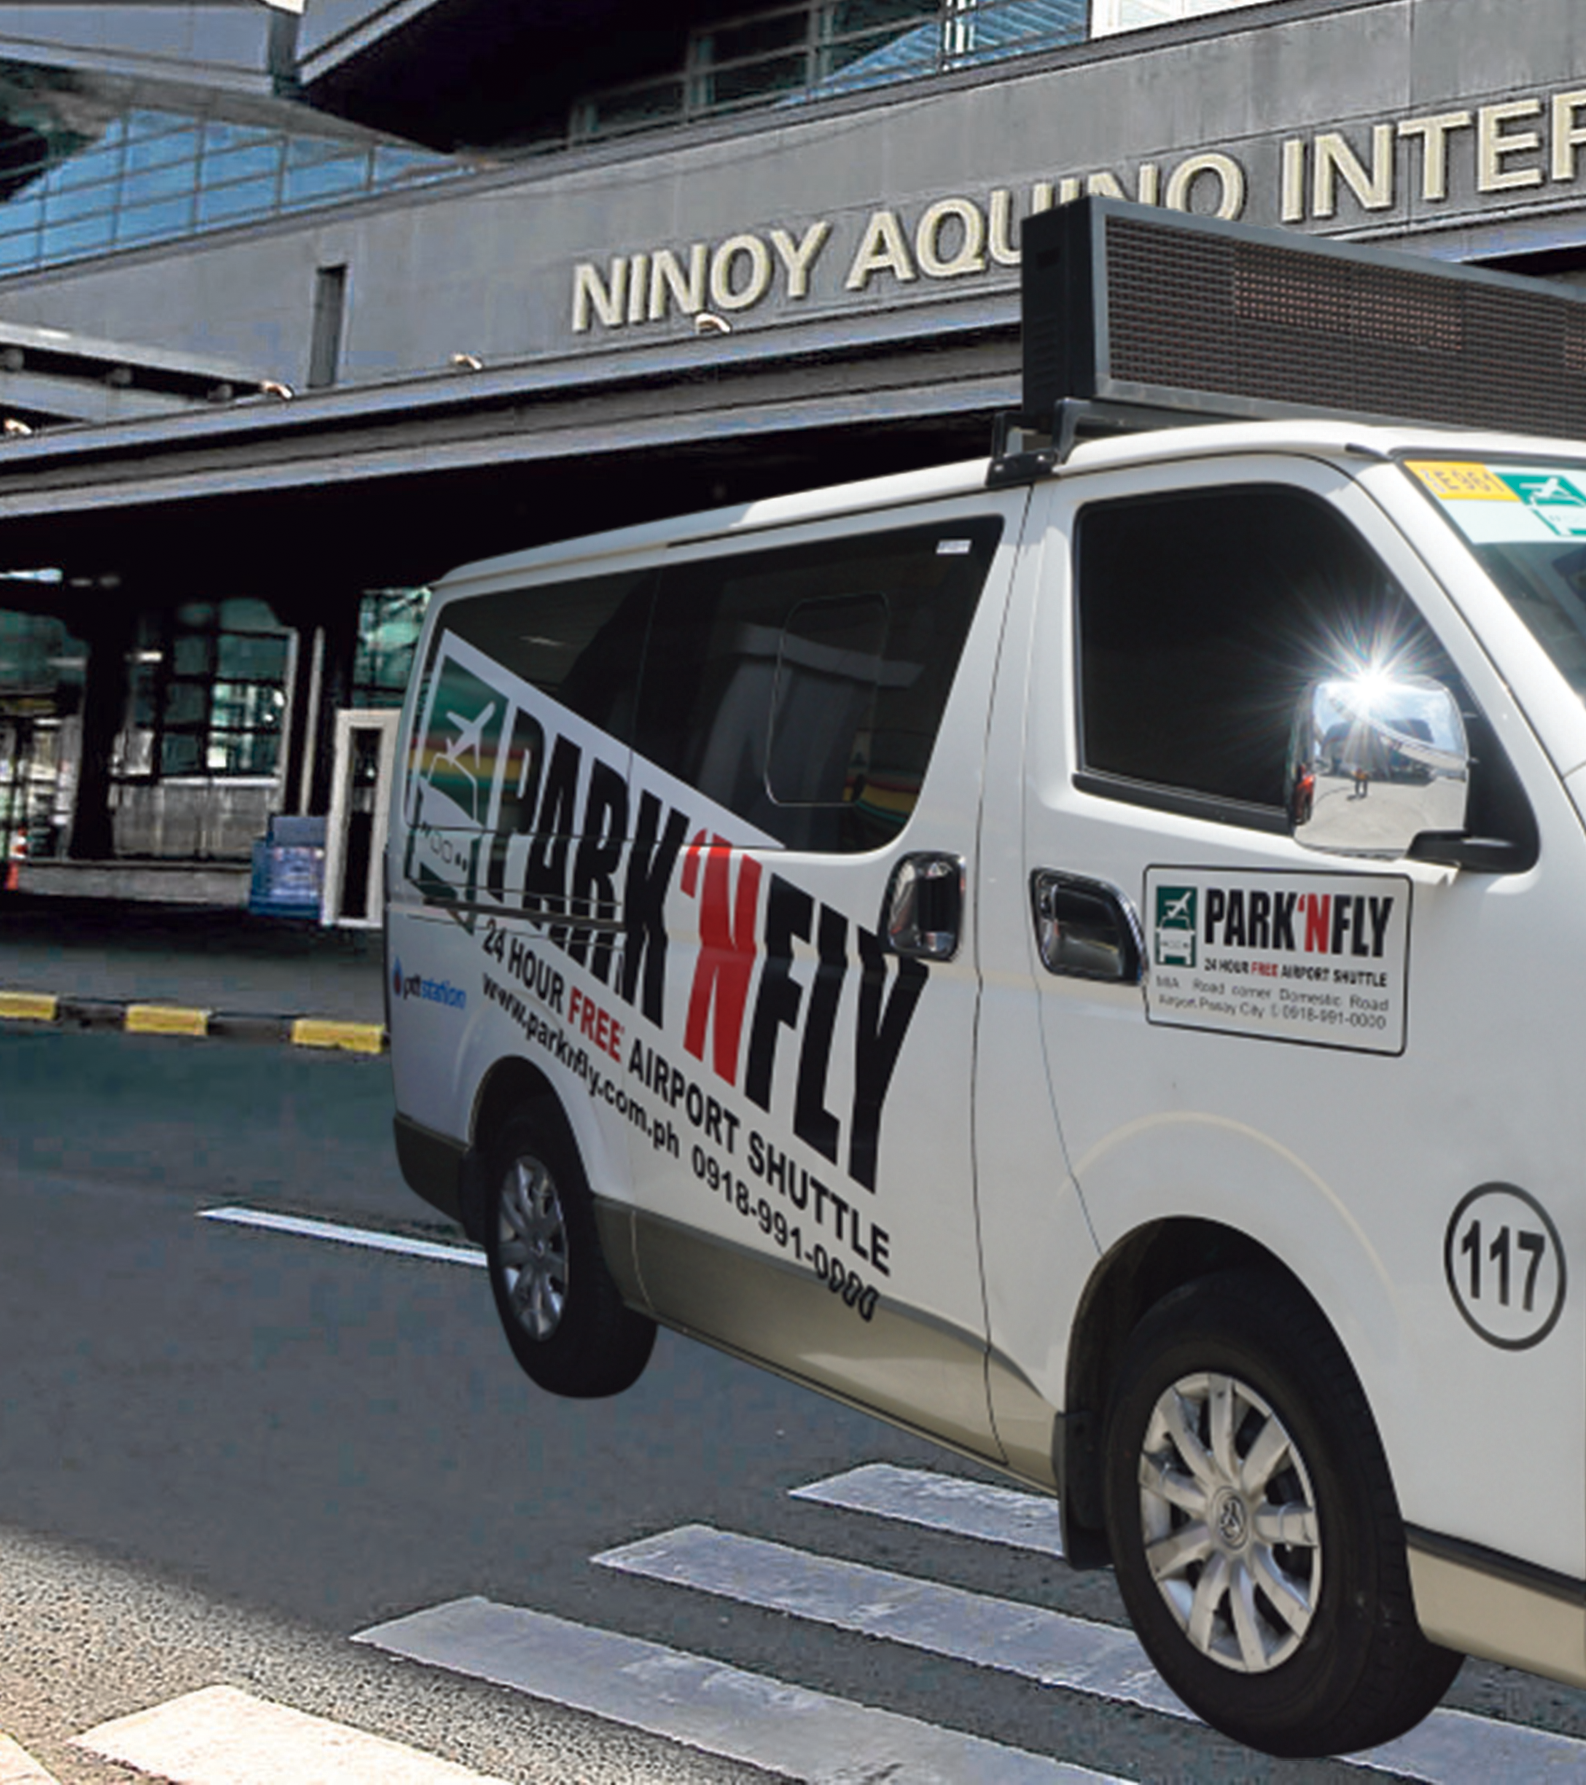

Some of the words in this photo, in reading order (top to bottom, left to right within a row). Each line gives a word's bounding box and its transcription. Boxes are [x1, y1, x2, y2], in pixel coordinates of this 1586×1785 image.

[572, 221, 832, 332] NINOY
[1193, 978, 1225, 995] Road
[1231, 985, 1271, 999] corner
[1279, 988, 1341, 1007] Domestic
[1349, 994, 1389, 1011] Road
[1204, 958, 1217, 971] 24
[1219, 959, 1249, 974] HOUR
[1251, 961, 1278, 977] FREE
[1281, 964, 1329, 982] AIRPORT
[1333, 968, 1388, 988] SHUTTLE
[1239, 1001, 1265, 1019] City
[482, 917, 506, 963] 24
[508, 937, 564, 1014] HOUR
[628, 1037, 741, 1154] AIRPORT
[748, 1130, 891, 1277] SHUTTLE
[692, 1145, 880, 1322] 0918-991-0000
[1461, 1219, 1545, 1312] 117
